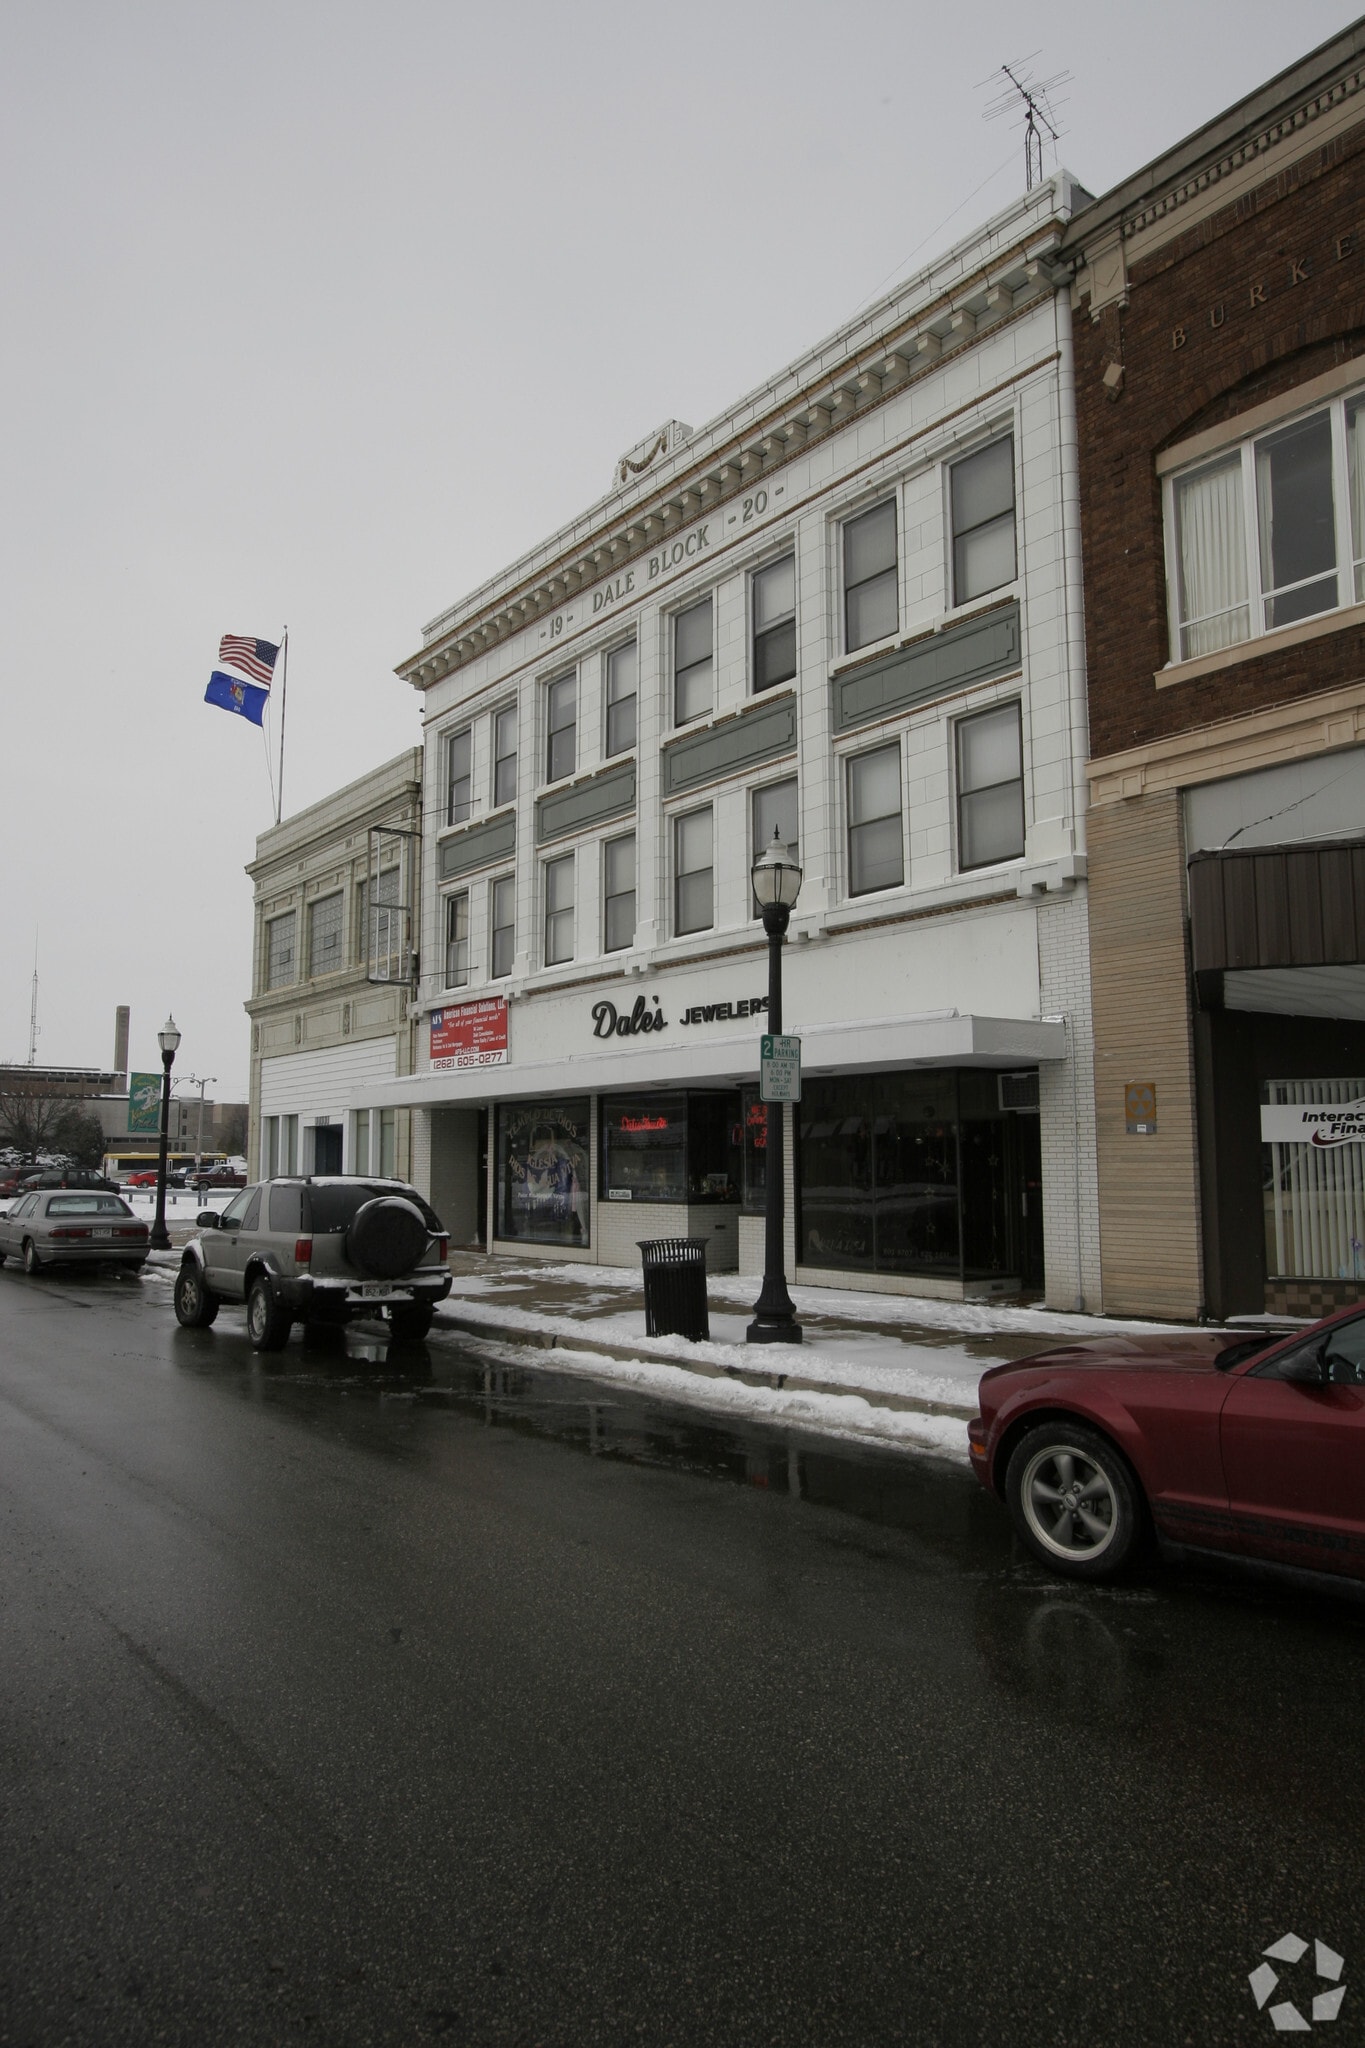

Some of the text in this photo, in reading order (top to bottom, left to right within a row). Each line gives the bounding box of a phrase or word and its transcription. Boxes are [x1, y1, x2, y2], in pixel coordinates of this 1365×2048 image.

[1172, 234, 1353, 350] BURKE
[592, 570, 637, 614] DALE
[647, 524, 710, 581] BLOCK
[461, 1004, 477, 1016] Financial
[591, 995, 669, 1039] Dale's
[679, 996, 770, 1026] JEWELERS
[432, 1014, 442, 1024] AFS
[764, 1041, 770, 1056] 2
[774, 1048, 798, 1058] PARKING
[433, 1052, 503, 1070] (262) 605-0277
[780, 1061, 788, 1069] AM
[557, 1112, 578, 1138] DIOS
[1302, 1112, 1365, 1123] Interac
[527, 1154, 558, 1171] IGLESIA
